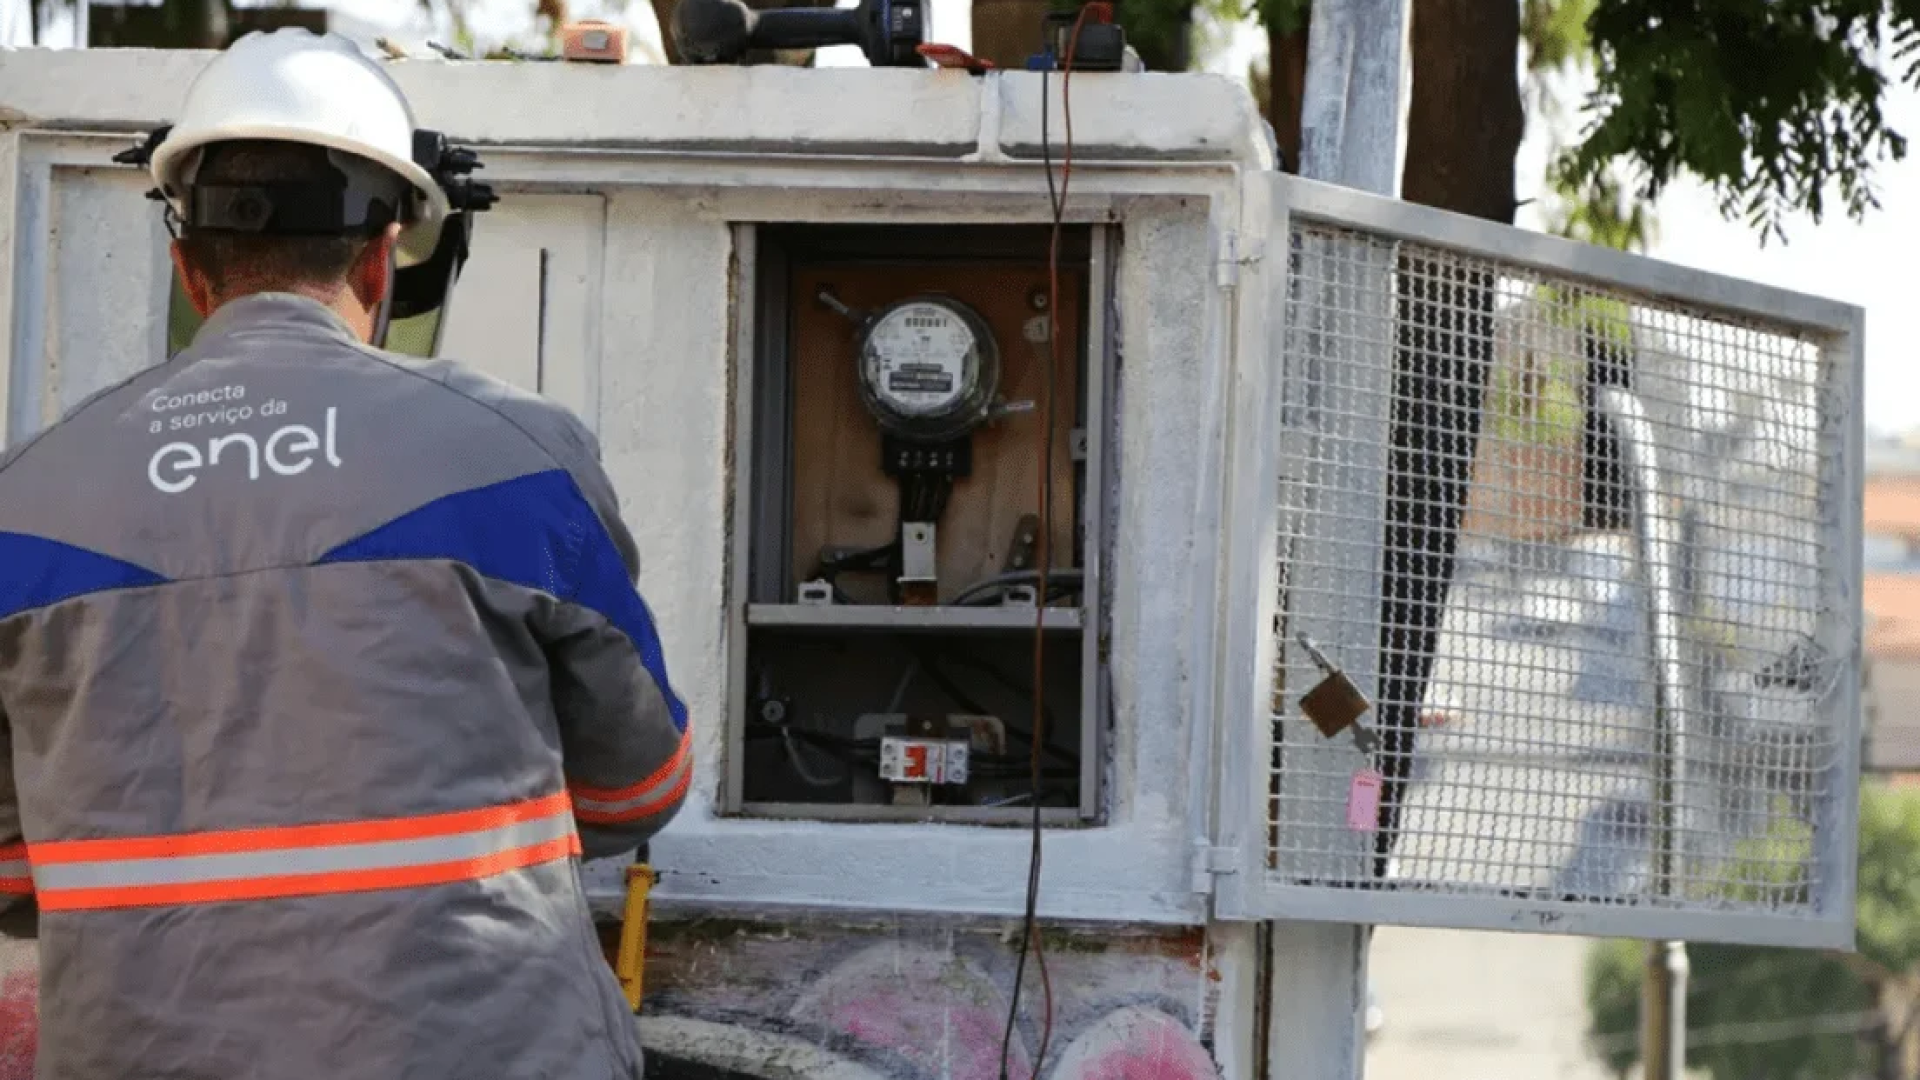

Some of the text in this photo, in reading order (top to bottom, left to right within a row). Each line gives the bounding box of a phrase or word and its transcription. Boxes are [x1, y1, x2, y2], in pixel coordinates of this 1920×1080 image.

[150, 398, 288, 433] a serviço da
[152, 384, 245, 412] Conecta
[148, 406, 342, 493] enel
